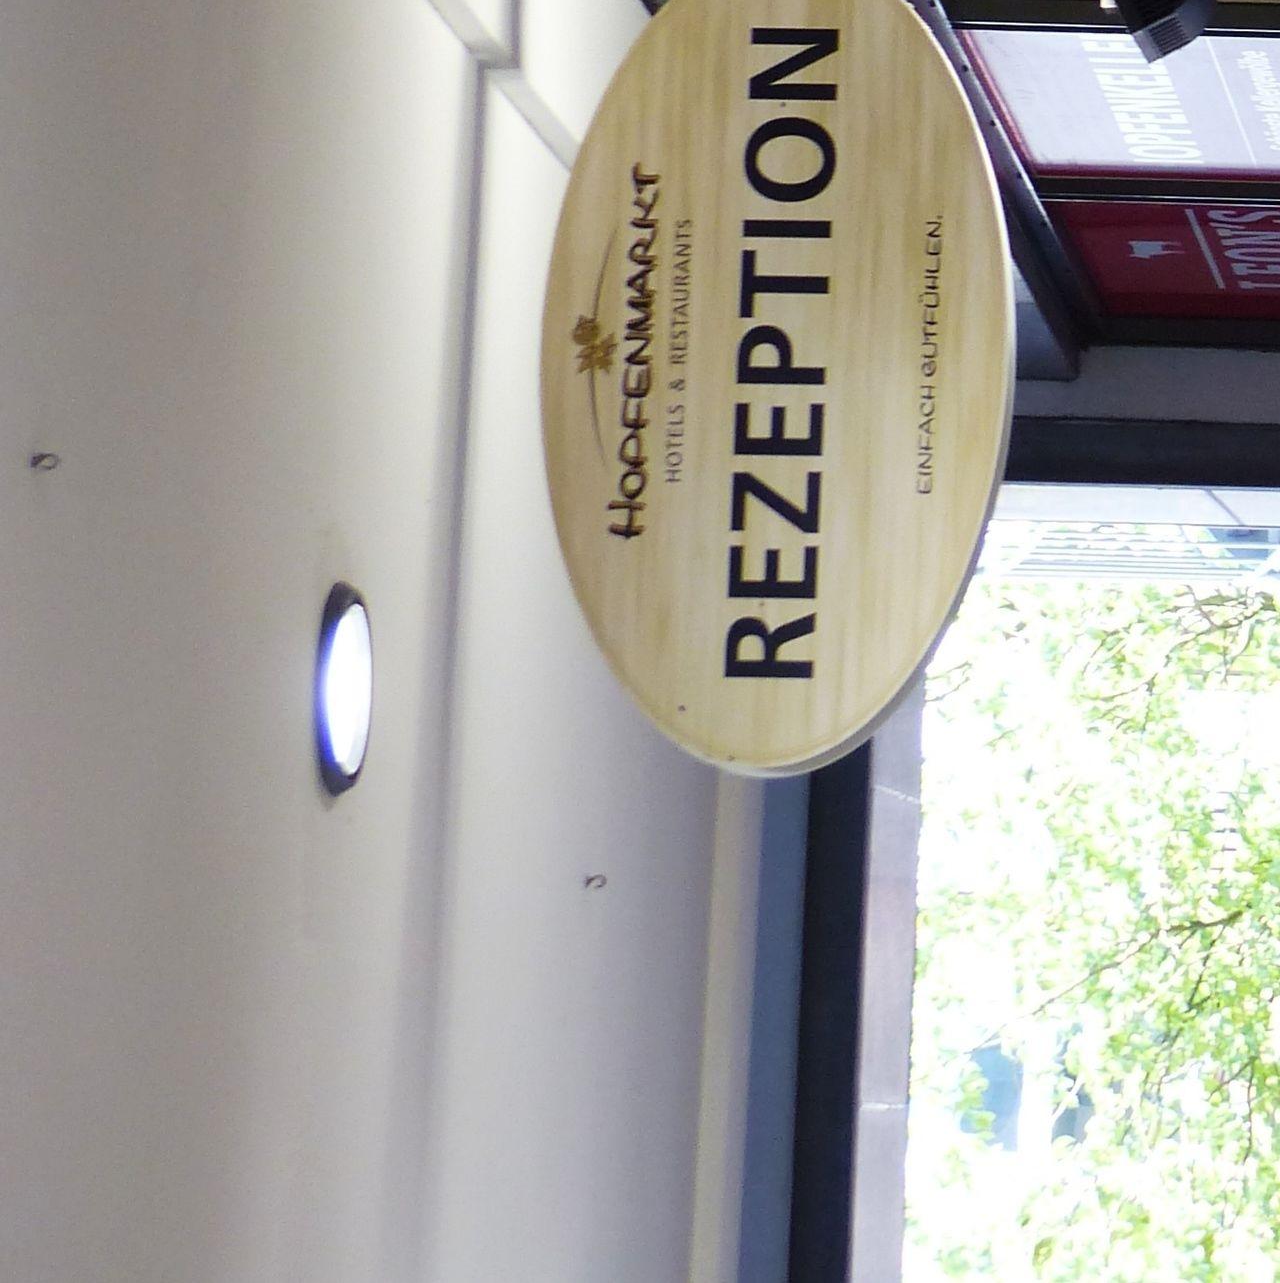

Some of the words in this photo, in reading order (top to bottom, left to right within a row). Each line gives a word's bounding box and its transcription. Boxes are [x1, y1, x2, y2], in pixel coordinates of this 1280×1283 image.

[606, 163, 660, 539] HOPFENMARKT
[670, 219, 692, 365] RESTAURANTS
[723, 25, 840, 680] REZEPTION
[918, 215, 943, 377] GUTFÜHLEN.
[664, 405, 686, 482] HOTELS
[668, 378, 686, 391] &
[916, 384, 937, 494] EINFACH
